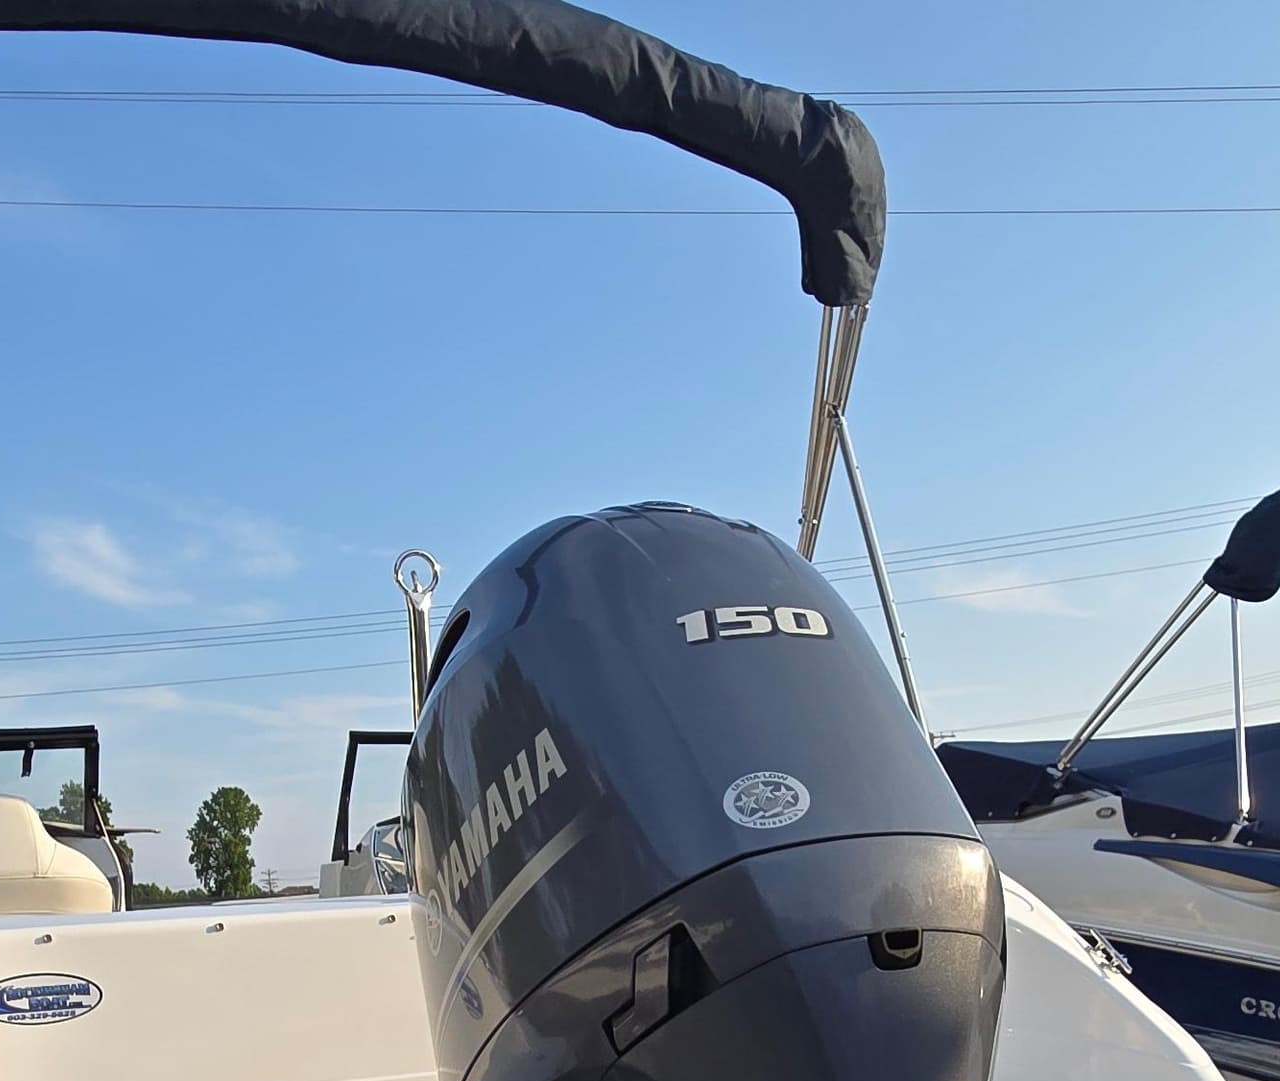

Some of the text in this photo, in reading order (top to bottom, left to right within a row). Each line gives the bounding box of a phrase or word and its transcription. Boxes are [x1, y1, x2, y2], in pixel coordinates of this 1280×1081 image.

[675, 605, 829, 643] 150
[762, 772, 789, 781] LOW
[436, 727, 568, 922] YAMAHA
